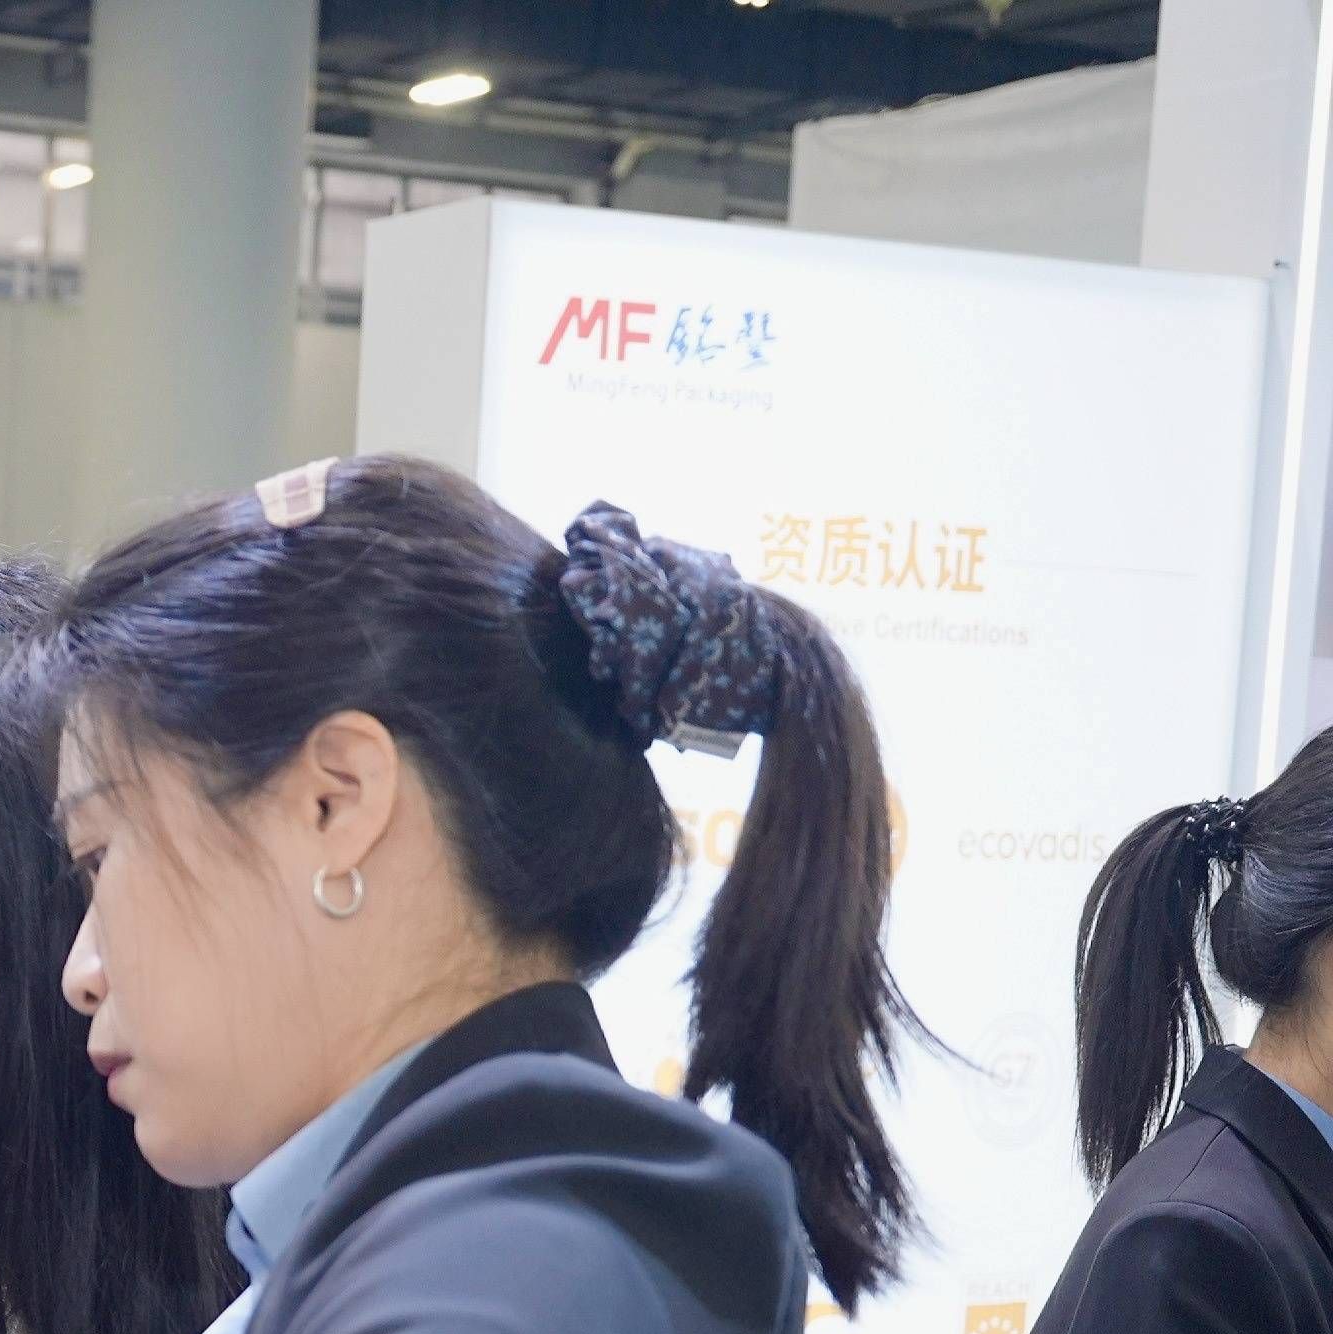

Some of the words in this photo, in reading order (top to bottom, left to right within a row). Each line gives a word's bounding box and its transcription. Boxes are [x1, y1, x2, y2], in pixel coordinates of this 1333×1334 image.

[538, 297, 656, 364] MF
[567, 373, 669, 403] MingFeng
[676, 381, 774, 413] Packaging
[757, 513, 988, 592] 资质认证
[874, 614, 1030, 647] Certifications
[958, 822, 1109, 864] ecovadis
